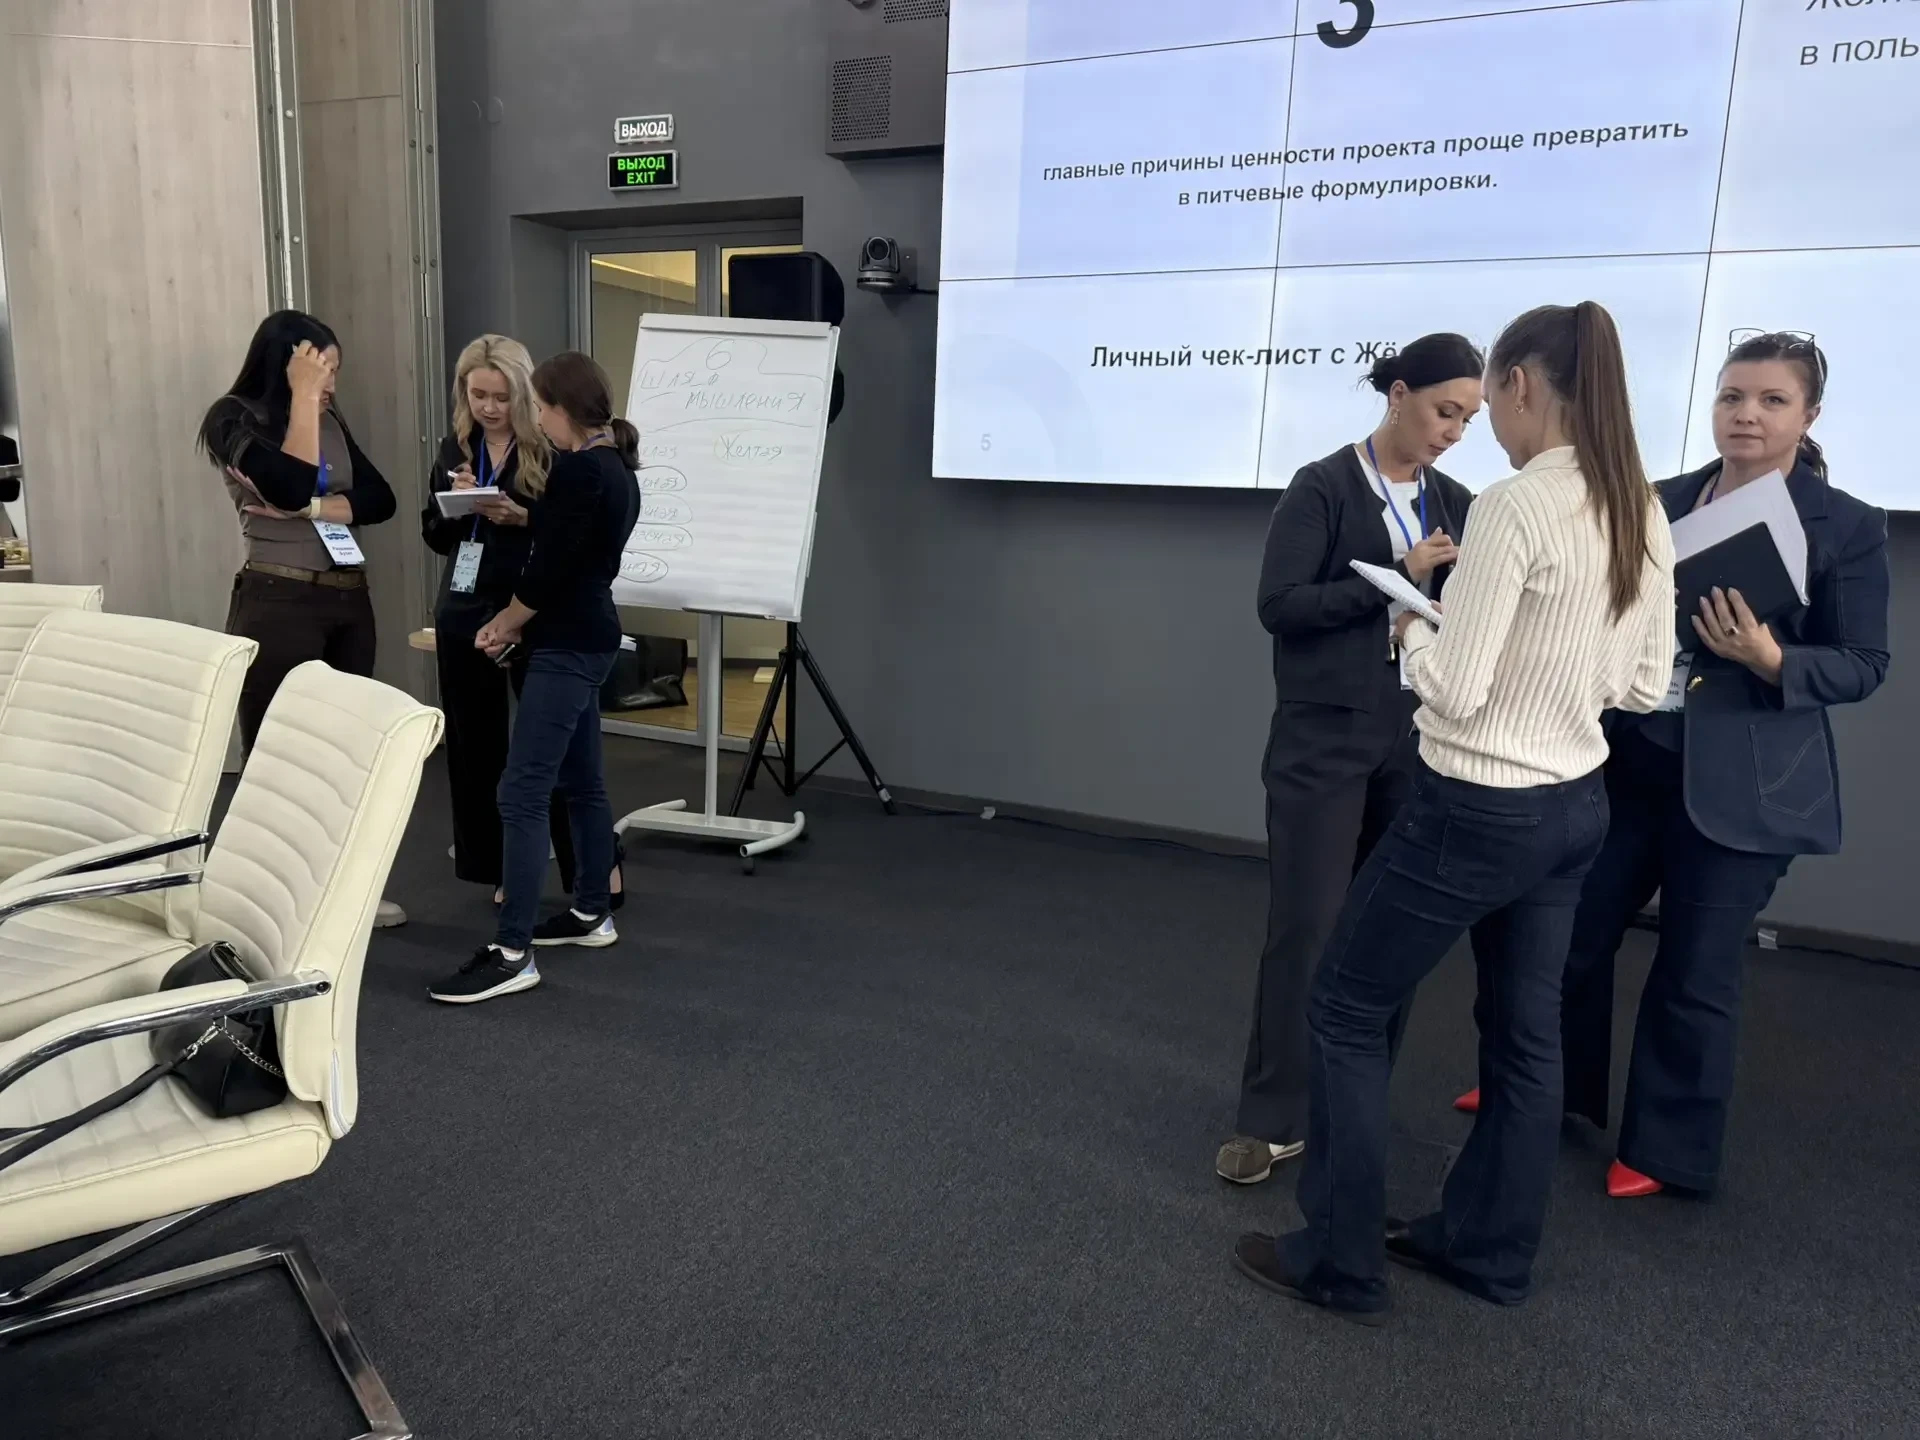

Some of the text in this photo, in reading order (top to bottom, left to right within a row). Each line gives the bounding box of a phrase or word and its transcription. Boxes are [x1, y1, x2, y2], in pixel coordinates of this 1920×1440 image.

[1800, 45, 1819, 65] в
[621, 121, 668, 137] ВЫХОД
[1043, 122, 1689, 181] главные причины ценности проекта проще превратить
[617, 156, 666, 171] ВЫХОД
[627, 171, 656, 184] EXIT
[1178, 174, 1498, 206] в питчевые формулировки.
[705, 338, 735, 371] 6
[1090, 344, 1192, 368] Личный
[1201, 347, 1322, 366] чек-лист
[1330, 347, 1346, 365] с
[980, 433, 992, 452] 5
